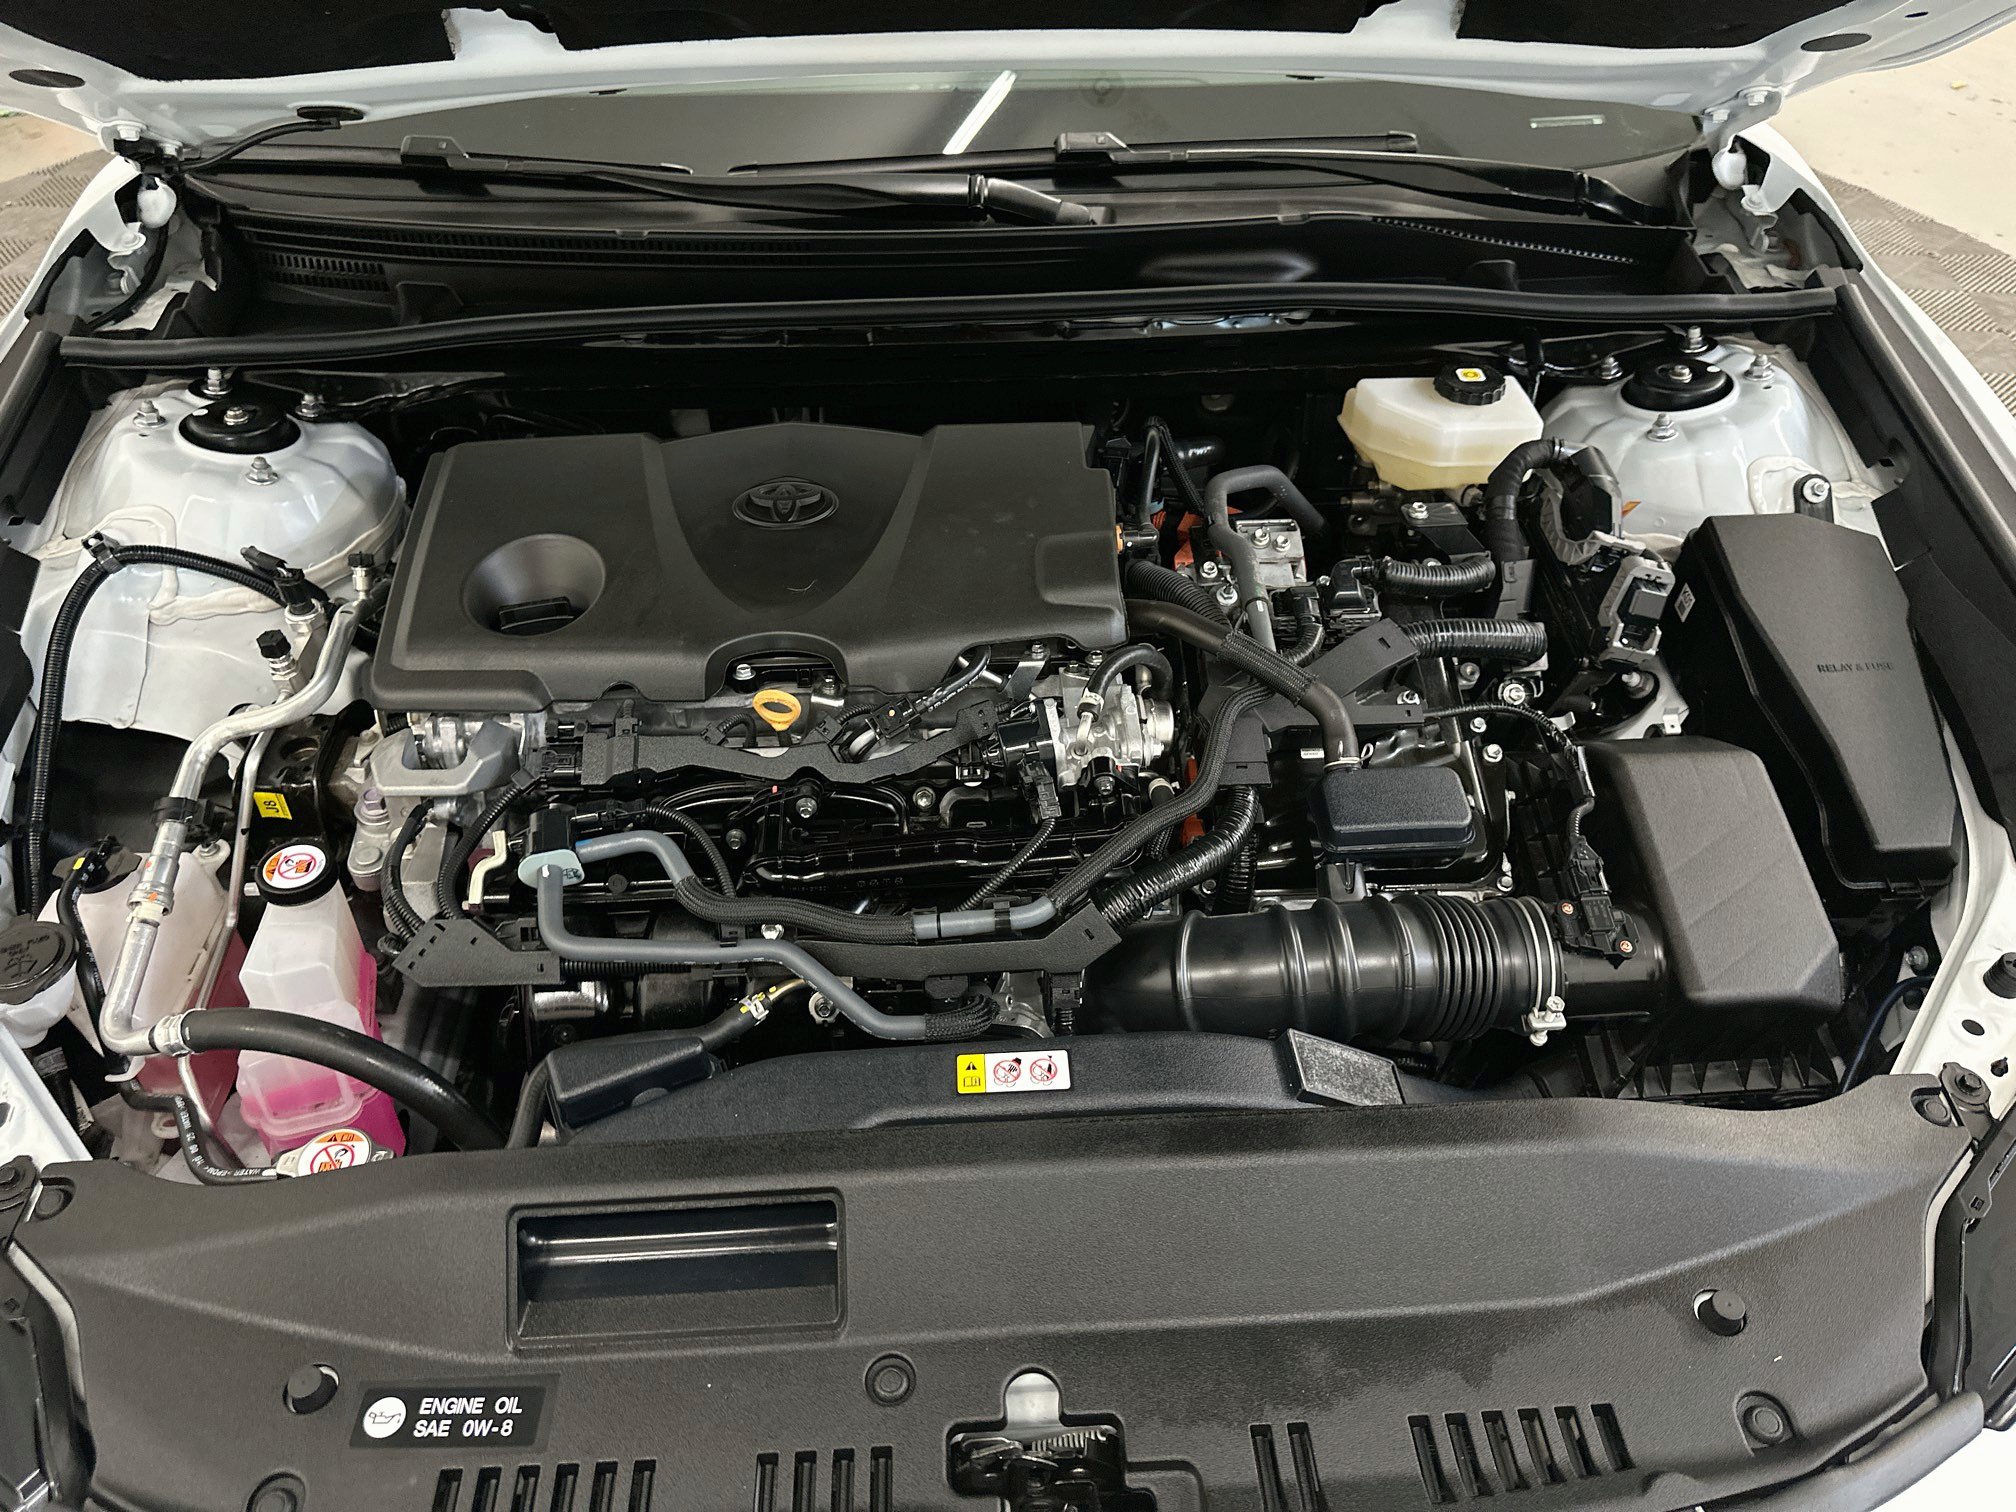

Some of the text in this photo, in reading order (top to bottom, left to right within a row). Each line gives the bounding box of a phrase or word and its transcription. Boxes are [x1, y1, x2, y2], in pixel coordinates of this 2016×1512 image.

[1817, 662, 1894, 673] RELAY & FUSE
[265, 802, 278, 812] J8
[233, 1168, 261, 1176] WATER
[419, 1396, 523, 1415] ENGINE OIL
[413, 1419, 514, 1438] SAE 0W-8
